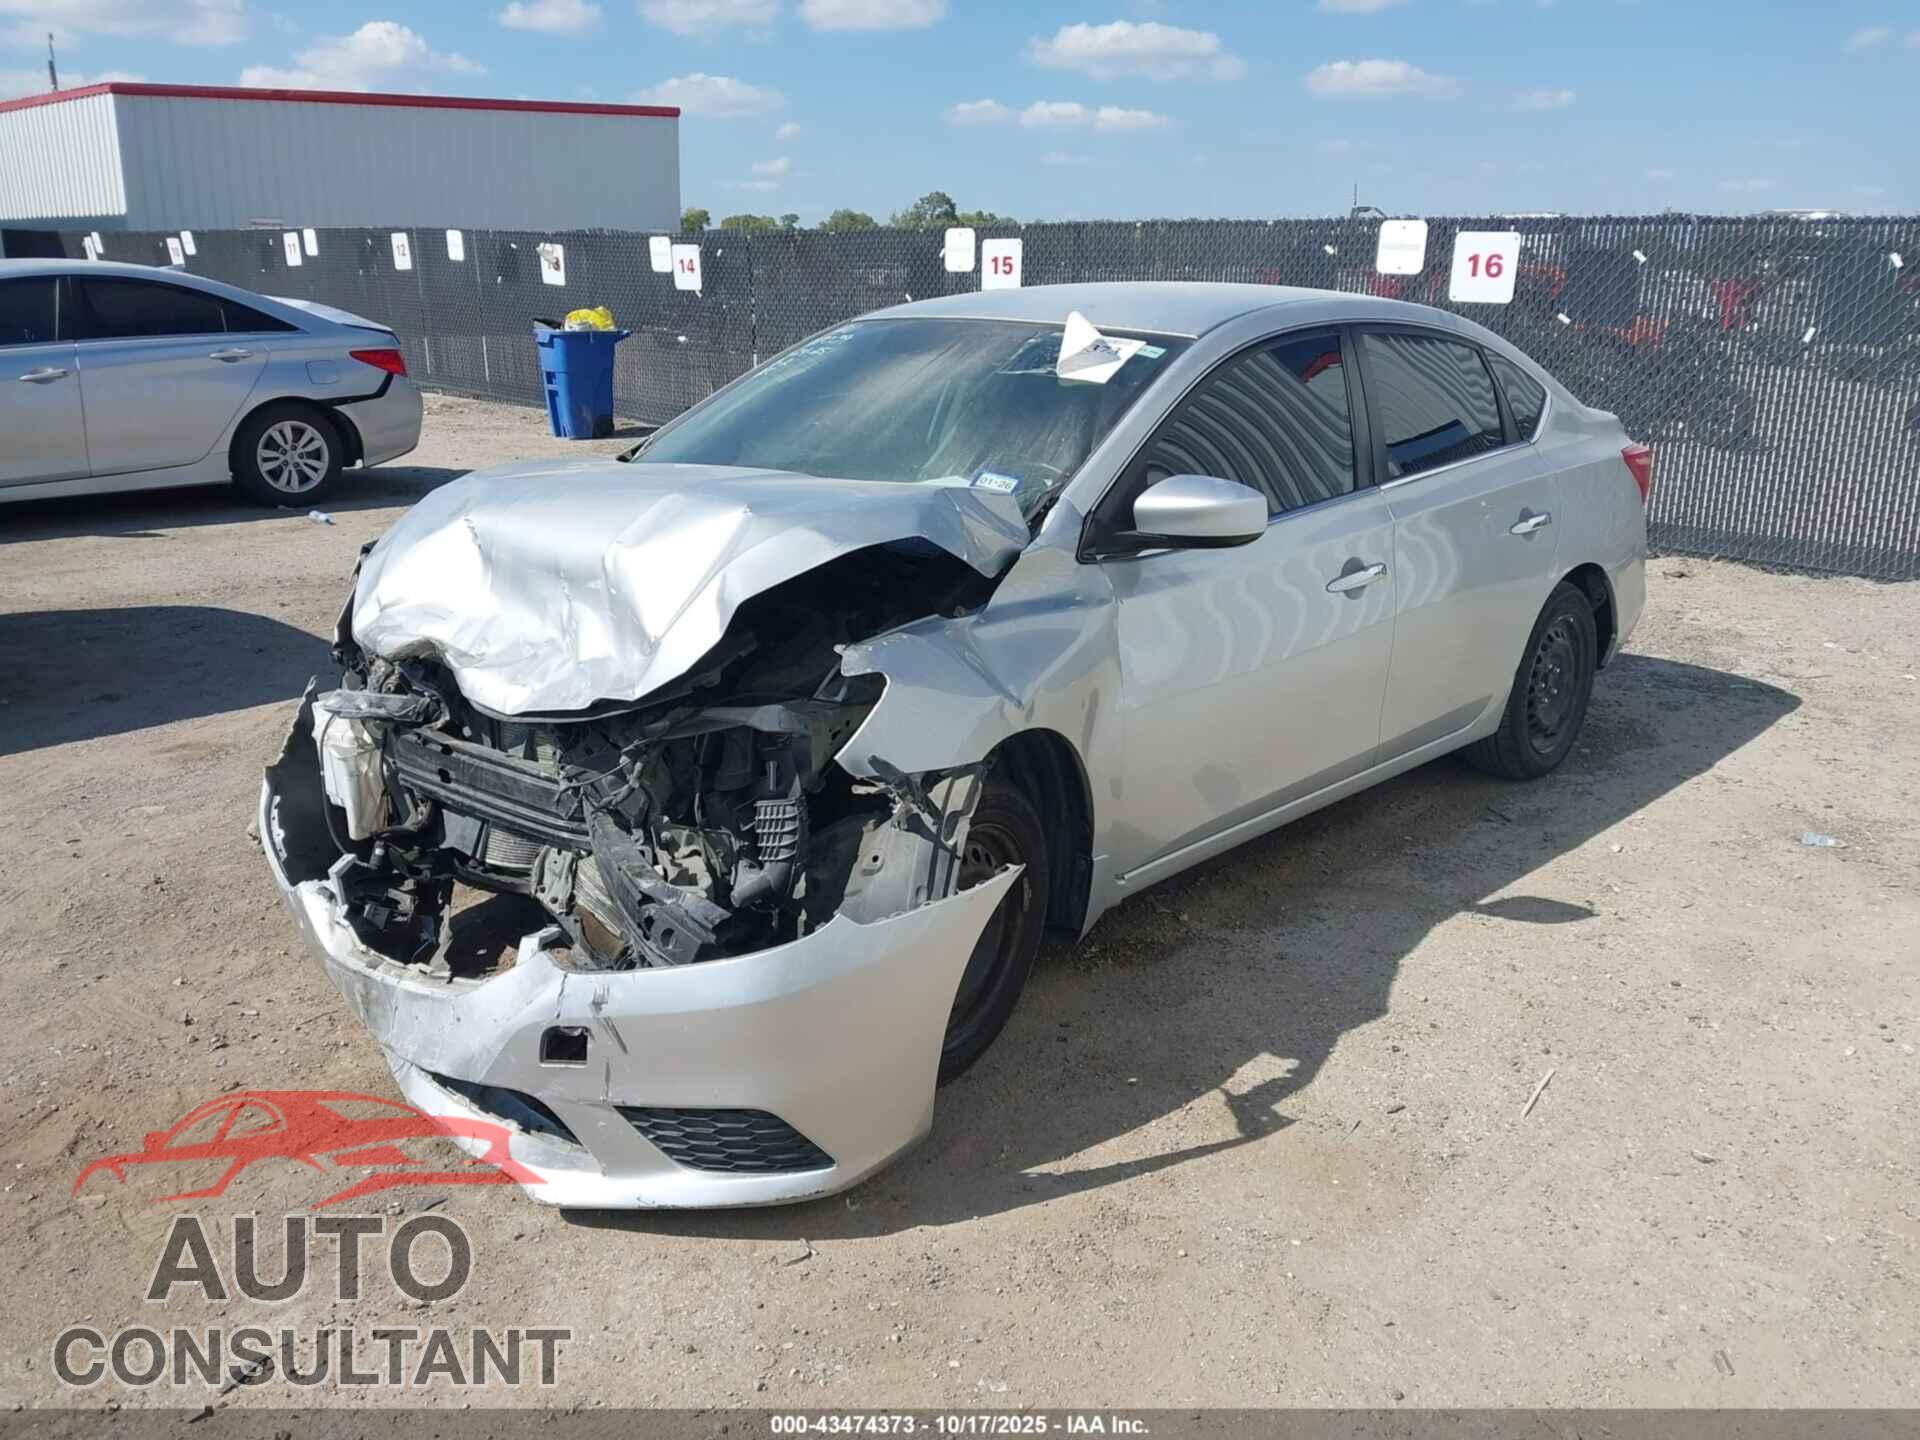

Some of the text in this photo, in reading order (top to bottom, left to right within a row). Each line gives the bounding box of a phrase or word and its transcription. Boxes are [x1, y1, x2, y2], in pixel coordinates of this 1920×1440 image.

[397, 244, 407, 256] 12
[679, 258, 695, 273] 14
[991, 256, 1014, 275] 15
[1468, 253, 1504, 278] 16
